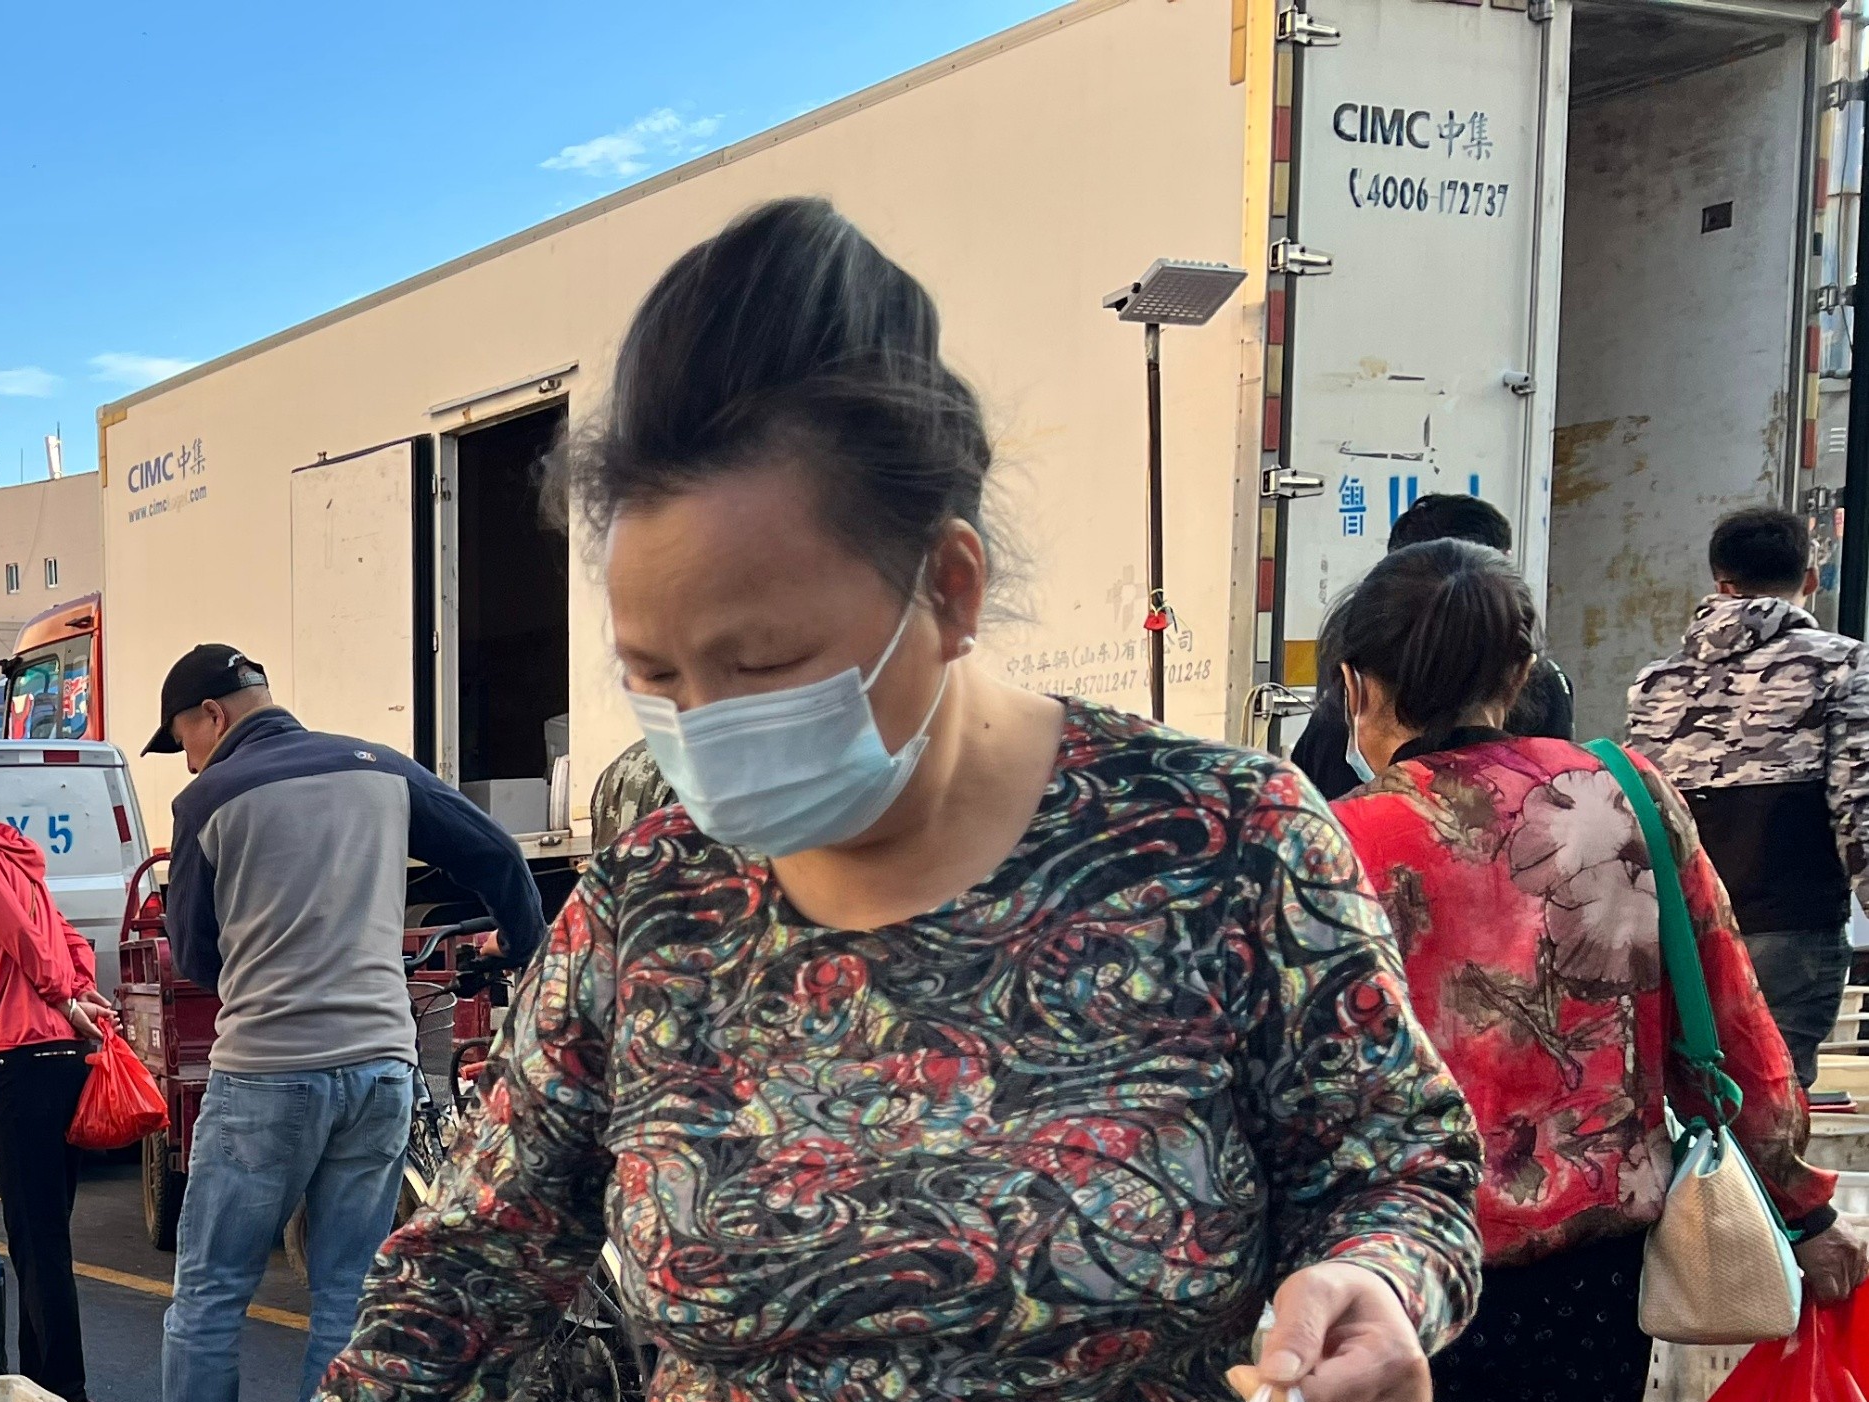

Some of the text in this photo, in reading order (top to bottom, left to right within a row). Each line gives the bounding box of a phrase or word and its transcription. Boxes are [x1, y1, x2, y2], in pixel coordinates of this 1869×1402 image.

[1333, 102, 1493, 160] CIMC 中集
[1367, 173, 1509, 218] 4006-172737
[128, 438, 206, 493] CIMC 中集
[129, 486, 207, 523] www.cimc.com
